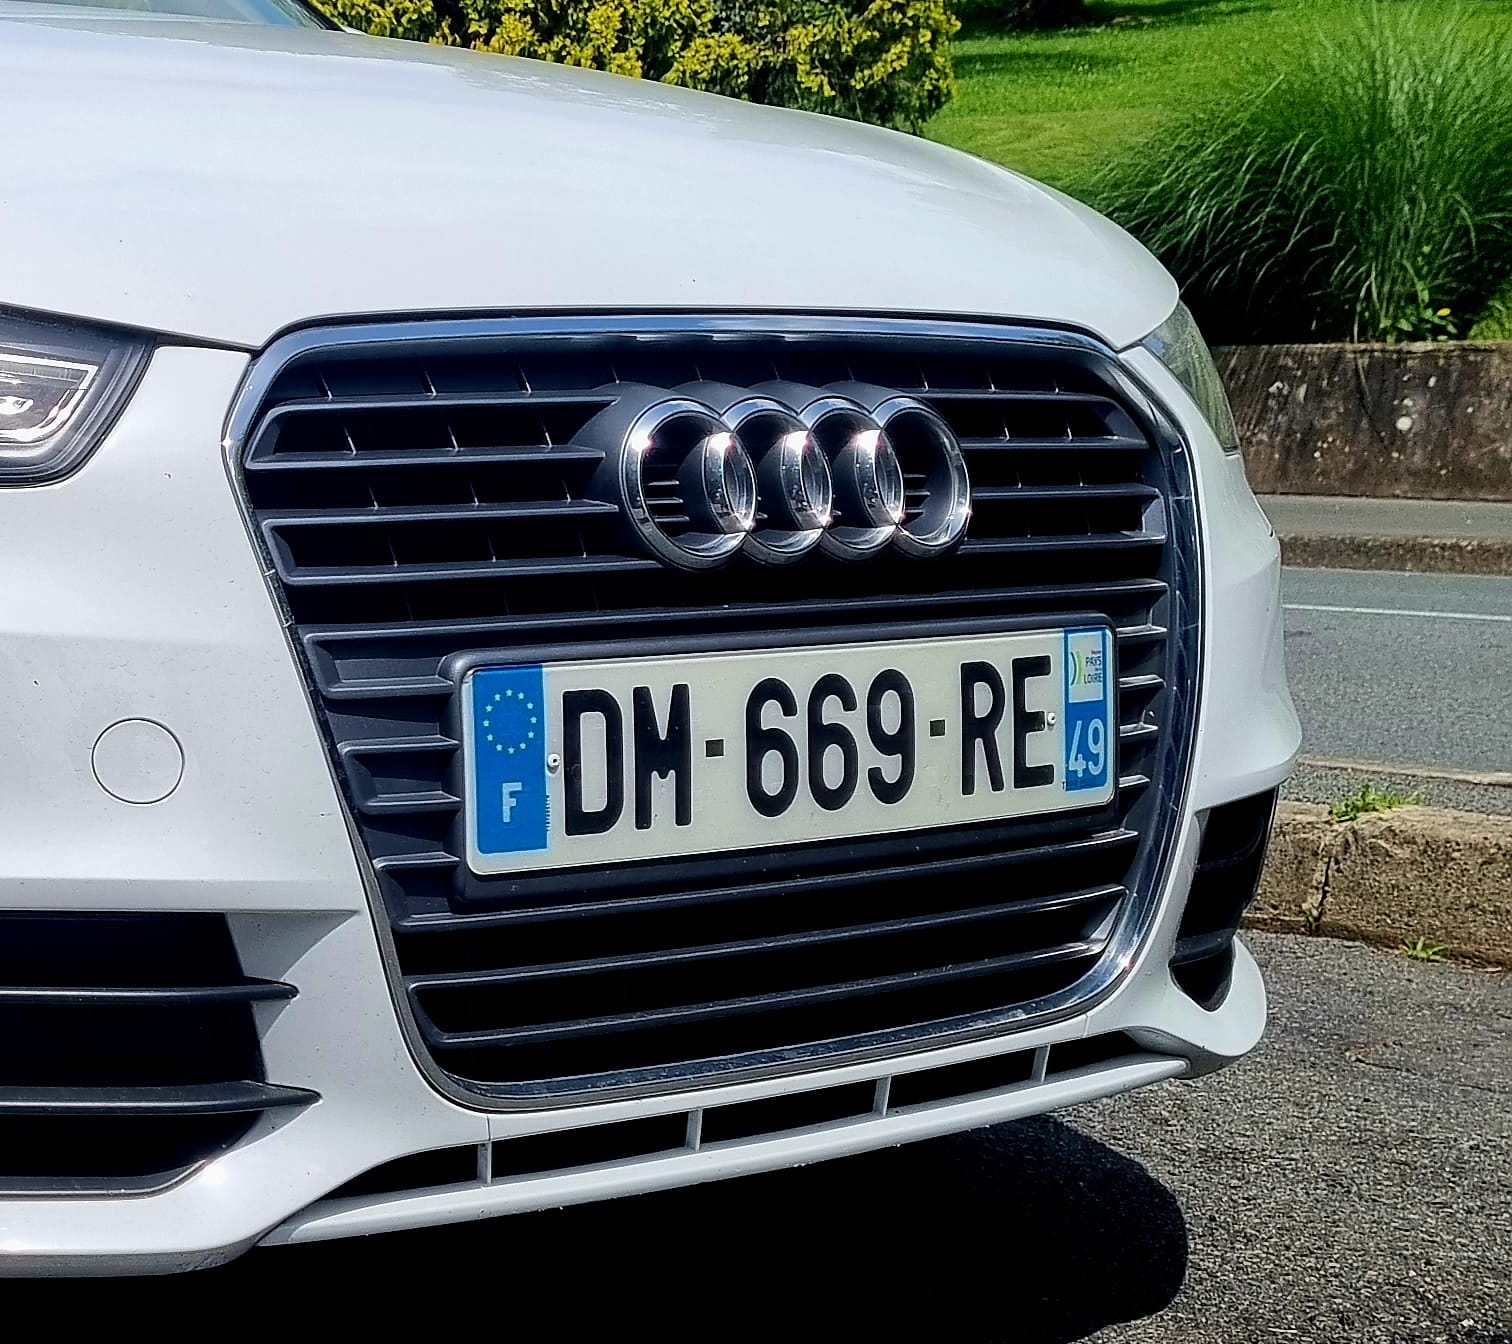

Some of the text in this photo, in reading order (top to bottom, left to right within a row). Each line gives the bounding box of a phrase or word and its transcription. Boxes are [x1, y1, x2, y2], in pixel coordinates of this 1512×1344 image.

[1083, 672, 1103, 685] LOIRE
[1085, 656, 1102, 667] PAYS
[562, 655, 1055, 837] DM-669-RE
[1068, 718, 1105, 778] 49
[502, 782, 522, 823] F
